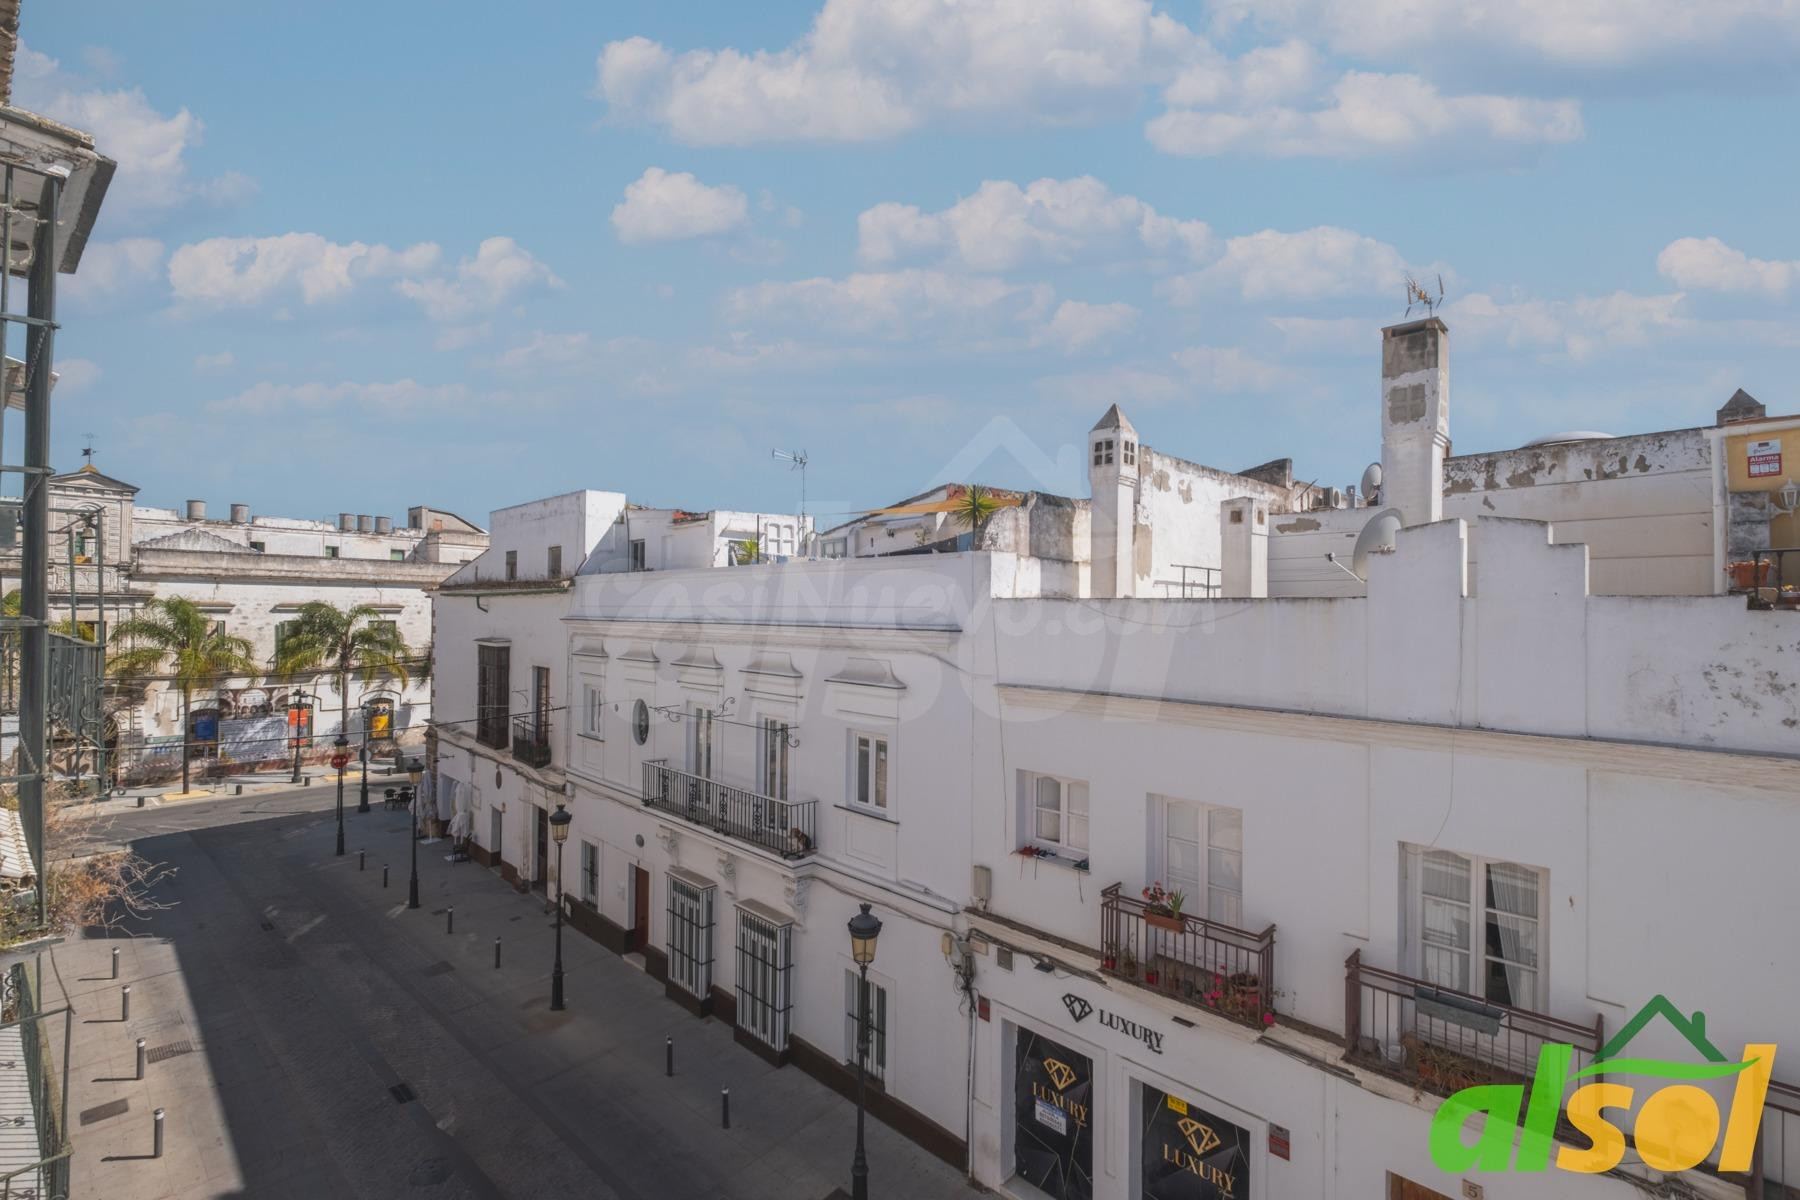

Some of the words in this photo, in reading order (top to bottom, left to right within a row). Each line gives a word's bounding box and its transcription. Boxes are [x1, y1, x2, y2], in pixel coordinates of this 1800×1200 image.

[1749, 455, 1780, 463] Alarma
[1099, 1009, 1164, 1054] LUXURY
[1033, 1081, 1087, 1127] LUXURY
[1162, 1143, 1235, 1198] LUXURY
[1468, 1185, 1477, 1198] 5
